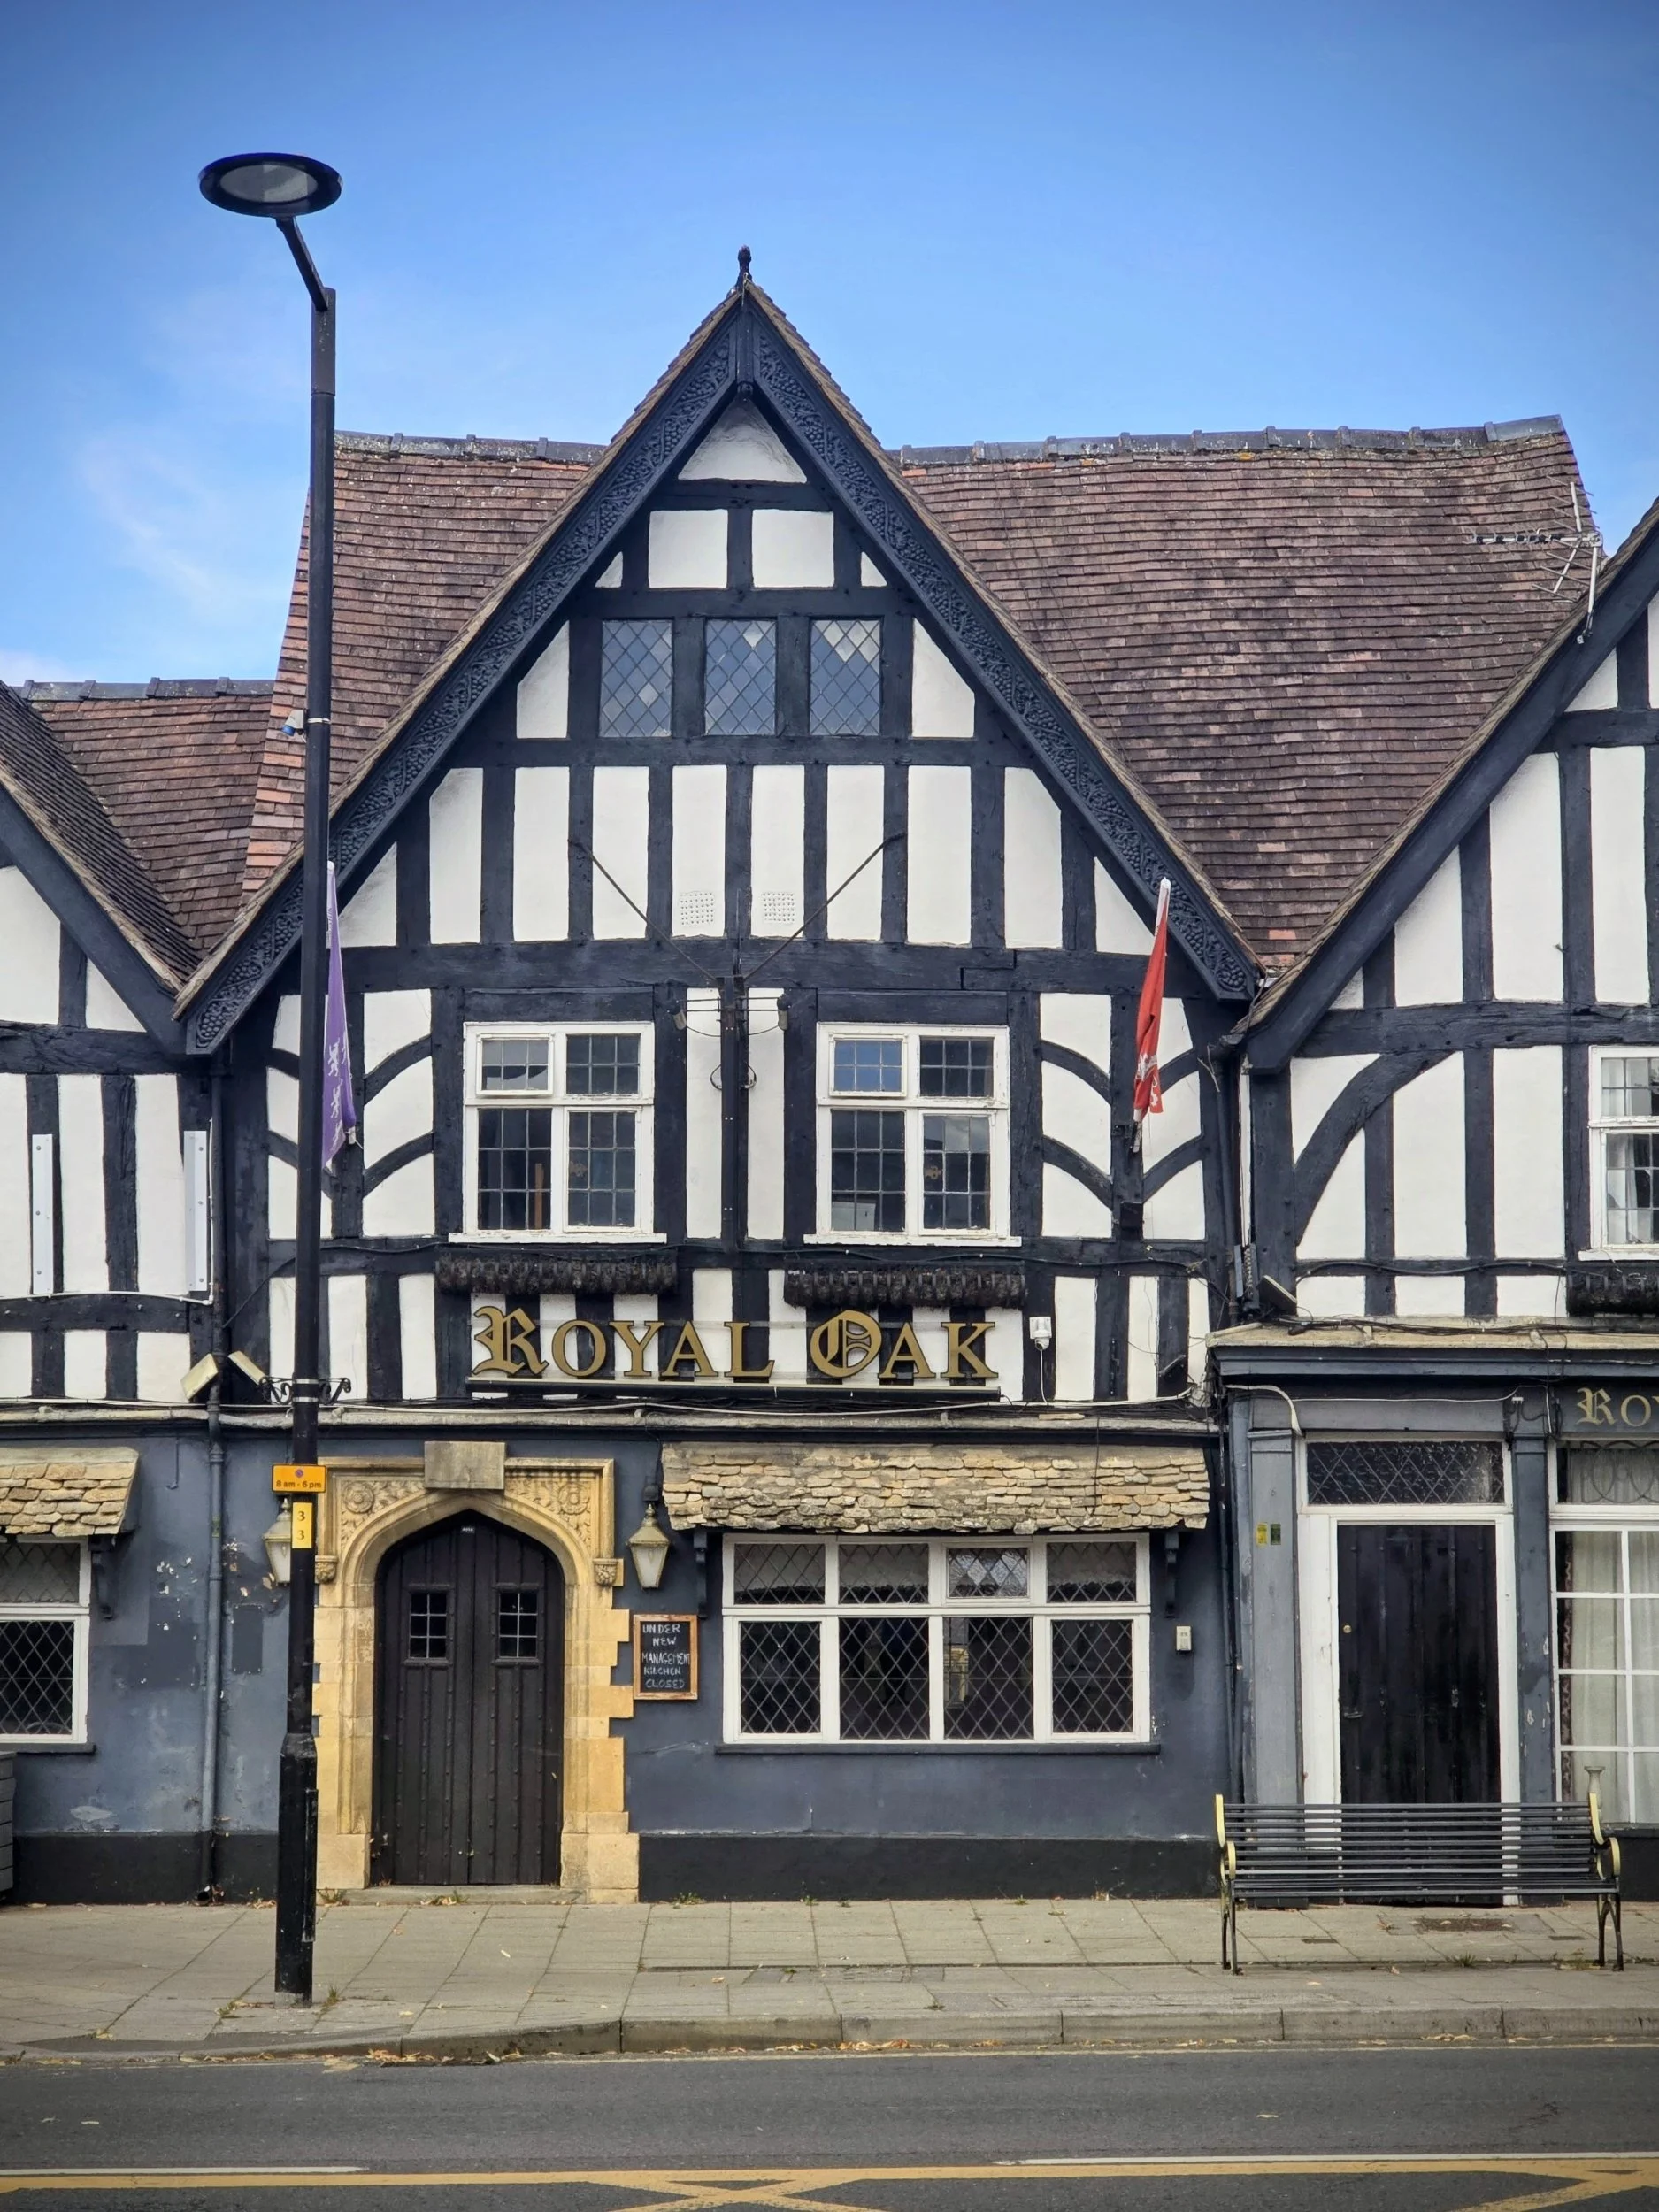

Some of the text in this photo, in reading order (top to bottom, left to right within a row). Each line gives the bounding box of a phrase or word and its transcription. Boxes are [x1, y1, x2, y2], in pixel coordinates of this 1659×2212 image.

[472, 1305, 999, 1379] ROYAL OAK
[1576, 1387, 1659, 1427] RO
[297, 1510, 305, 1522] 3
[297, 1530, 305, 1540] 3
[642, 1624, 680, 1633] UNDER
[652, 1636, 677, 1646] NEW
[641, 1652, 690, 1665] MANAGEMENT
[645, 1678, 685, 1689] CLOSED
